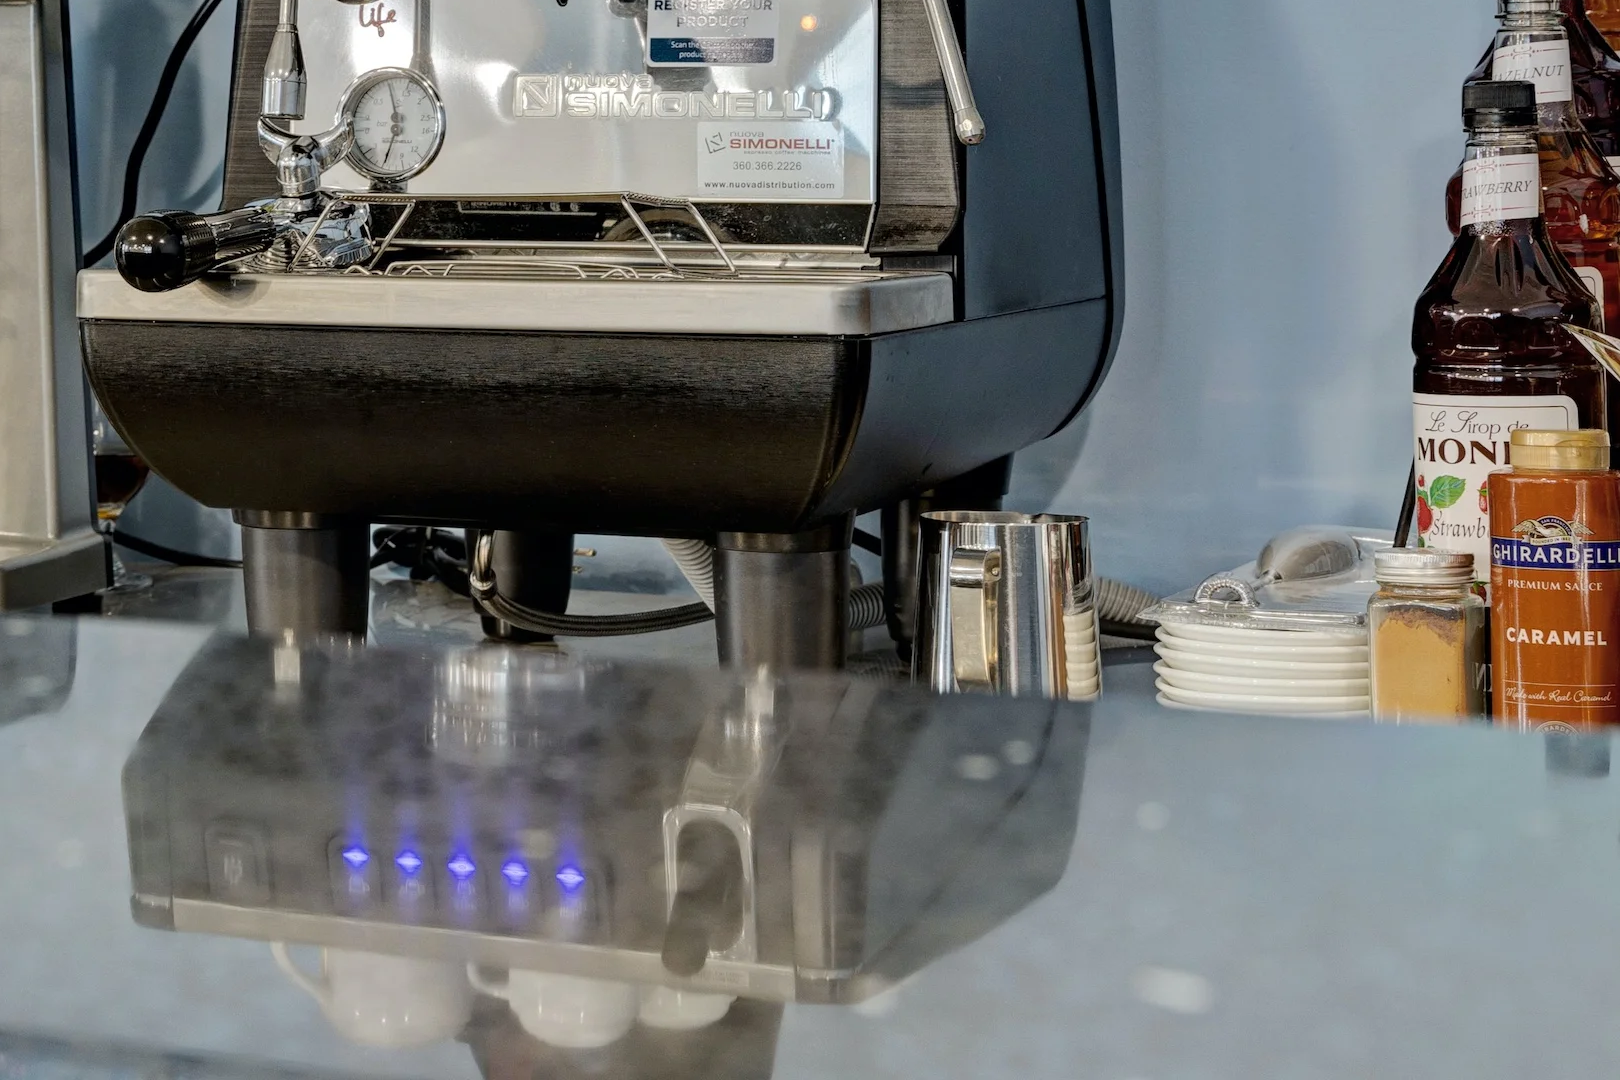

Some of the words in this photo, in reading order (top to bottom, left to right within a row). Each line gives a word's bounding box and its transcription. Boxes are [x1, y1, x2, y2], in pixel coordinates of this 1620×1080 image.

[654, 0, 725, 12] REGISTER
[730, 0, 772, 11] YOUR
[677, 15, 748, 28] PRODUCT
[670, 41, 687, 49] Scan
[565, 73, 653, 90] nuova
[566, 89, 824, 120] SIMONELLI
[730, 138, 832, 150] SIMONELLI
[733, 161, 802, 171] 360.366.2226
[704, 181, 835, 190] www.nuovadistribution.com
[1425, 410, 1447, 432] Le
[1450, 410, 1501, 440] Sirop
[1507, 579, 1561, 591] PREMIUM
[1564, 581, 1603, 592] SAUCE
[1506, 626, 1608, 647] CARAMEL
[1506, 686, 1527, 700] Made
[1527, 690, 1547, 701] with
[1548, 689, 1572, 703] Real
[1573, 690, 1613, 703] Caramel
